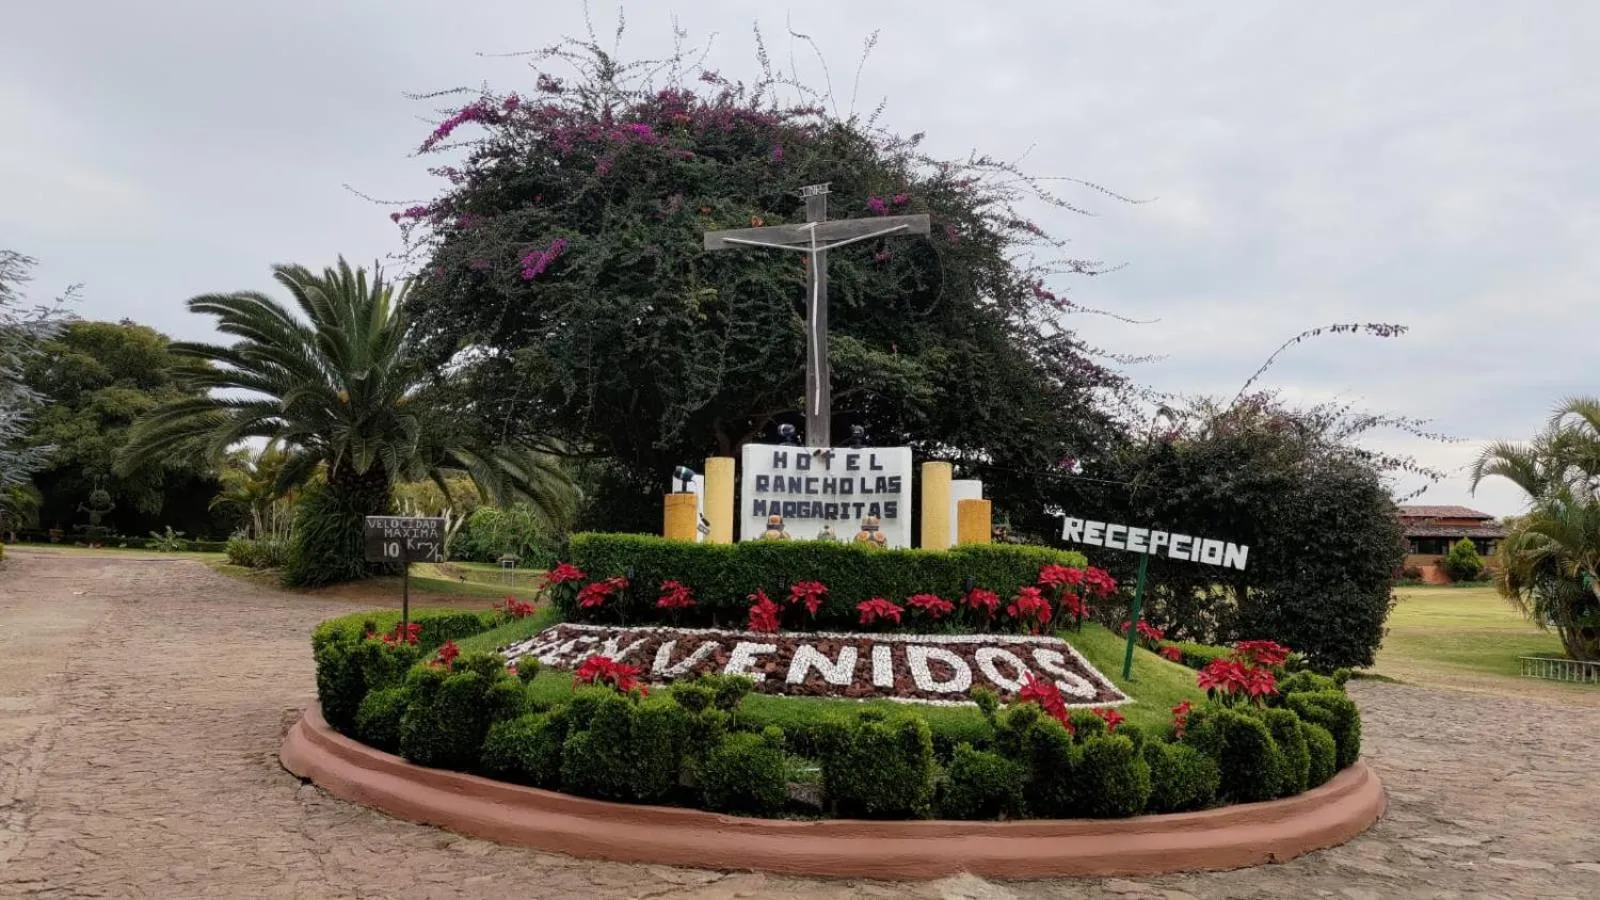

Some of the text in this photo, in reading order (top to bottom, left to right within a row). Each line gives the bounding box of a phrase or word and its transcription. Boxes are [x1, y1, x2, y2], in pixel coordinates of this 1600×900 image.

[773, 450, 883, 471] HOTEL
[755, 474, 902, 495] RANCHO LAS
[753, 498, 898, 520] MARGARITAS
[367, 519, 437, 529] VELOCIDAD
[384, 528, 438, 538] MAXIMA
[383, 541, 400, 558] 10
[1061, 516, 1249, 571] RECEPCION
